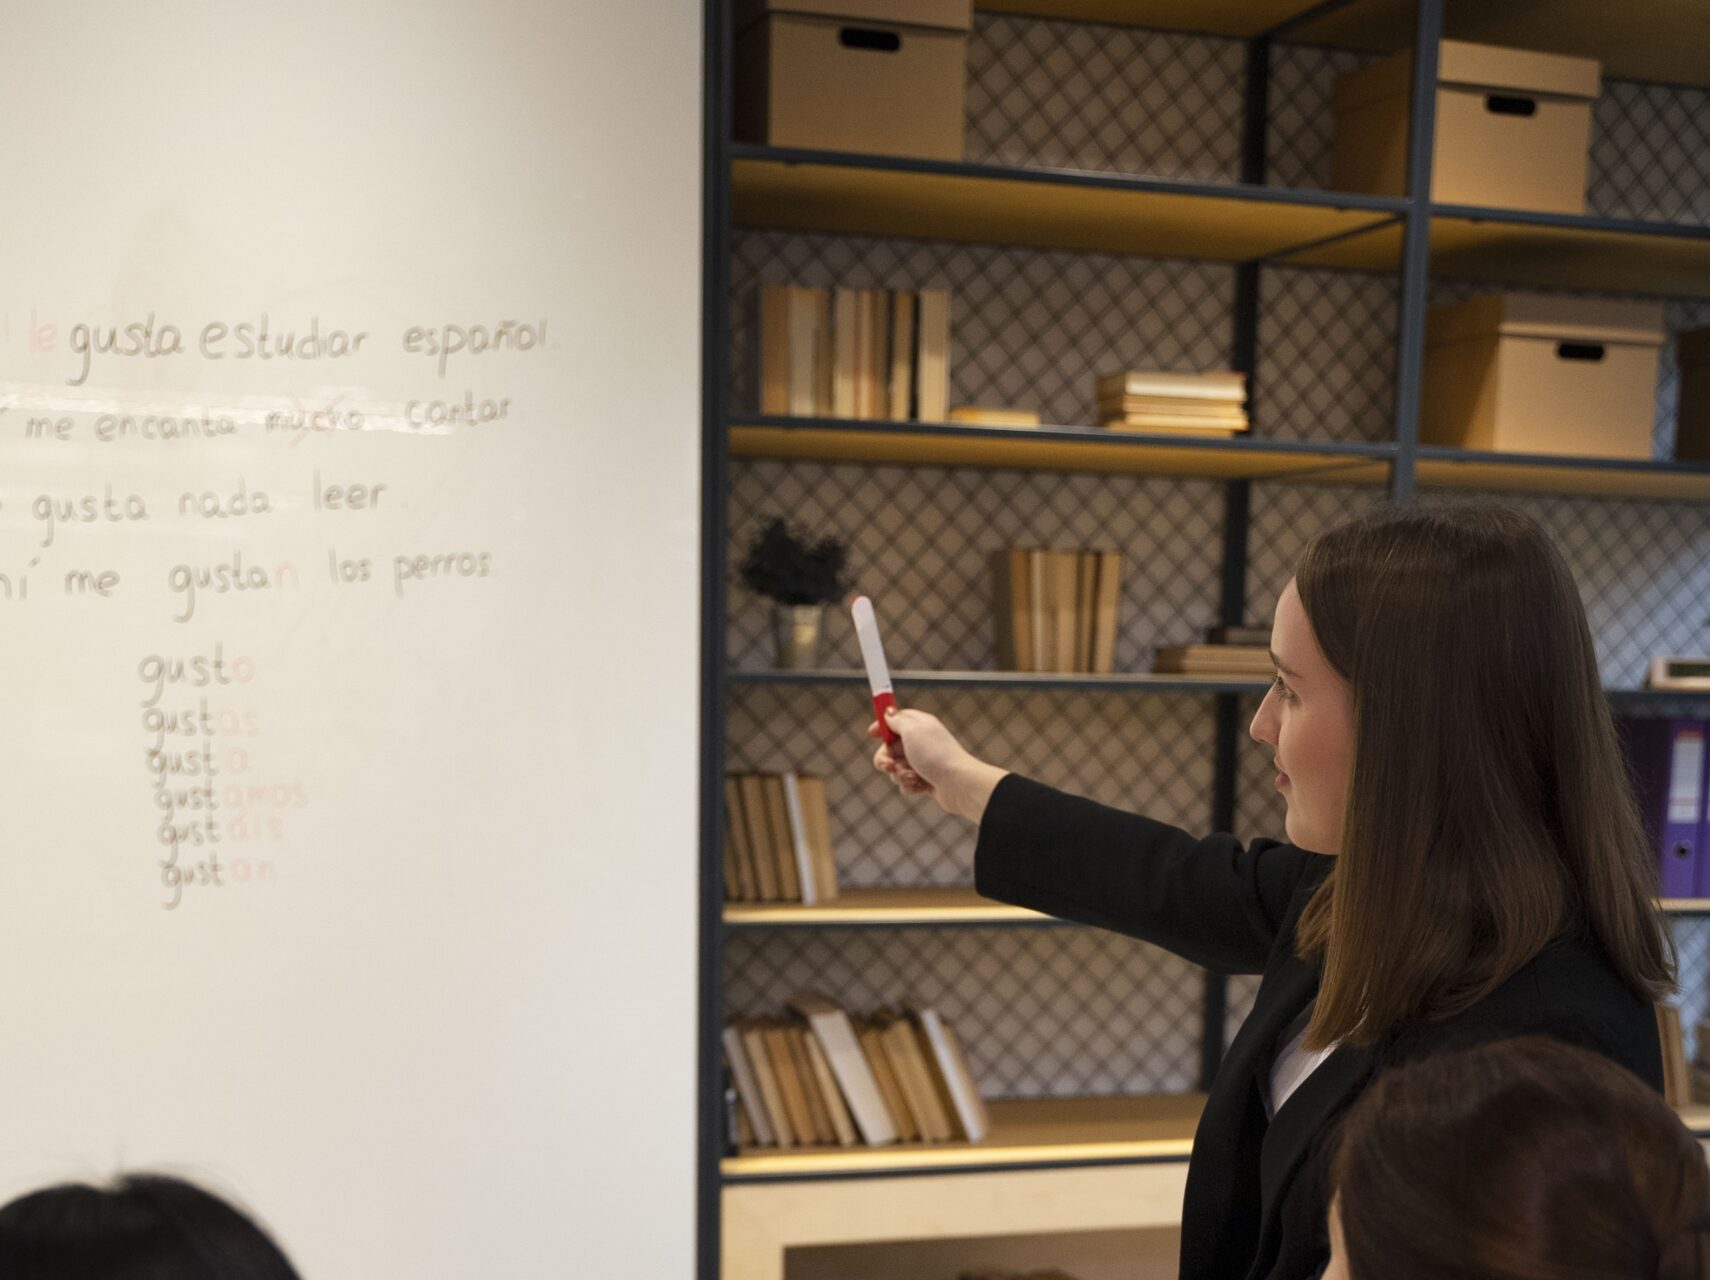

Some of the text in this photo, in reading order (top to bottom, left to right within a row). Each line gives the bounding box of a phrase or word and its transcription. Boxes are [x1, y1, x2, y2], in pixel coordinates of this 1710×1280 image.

[65, 311, 185, 387] gusta
[199, 312, 371, 361] estudiar
[25, 412, 74, 441] me
[94, 405, 237, 442] encanta
[402, 389, 514, 430] cantar
[32, 480, 150, 548] gusta
[178, 475, 273, 519] nada
[64, 566, 121, 598] me
[168, 549, 300, 622] gustan
[327, 546, 373, 585] los
[393, 550, 492, 600] perros
